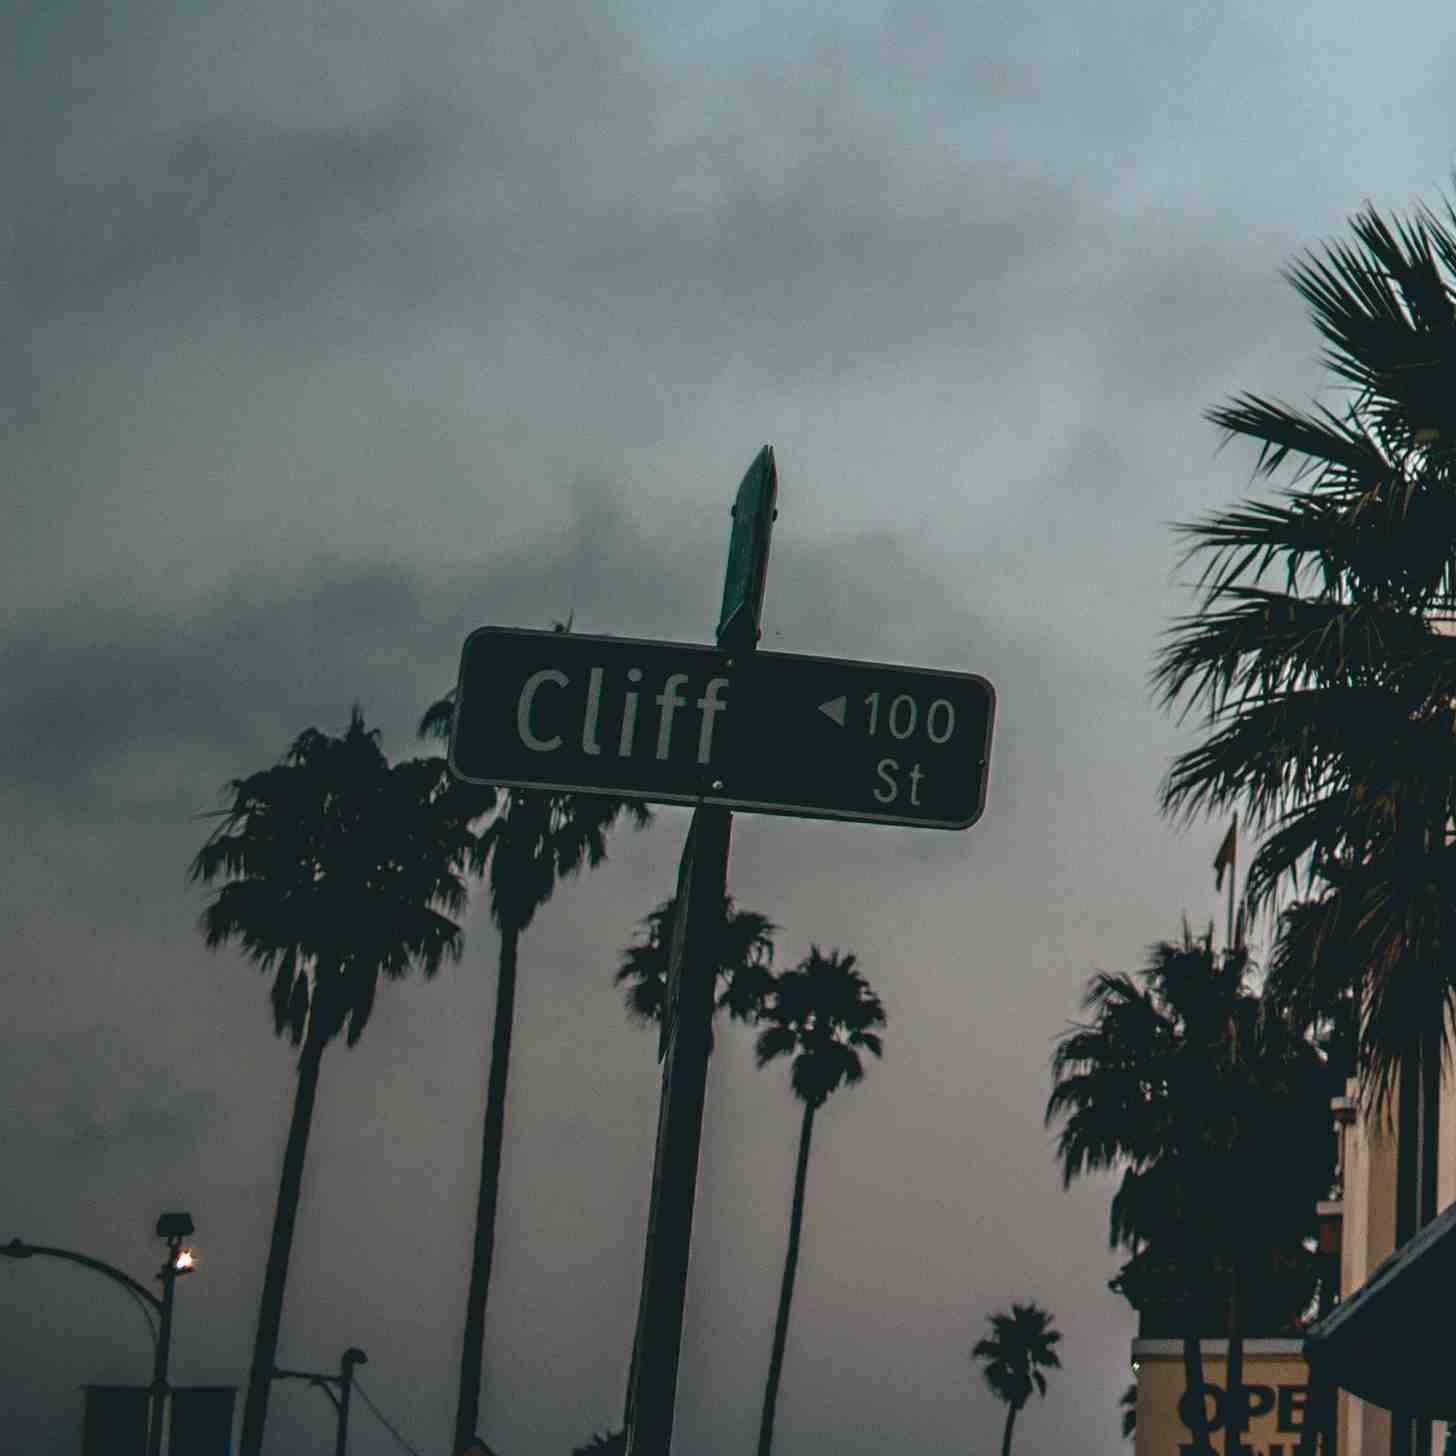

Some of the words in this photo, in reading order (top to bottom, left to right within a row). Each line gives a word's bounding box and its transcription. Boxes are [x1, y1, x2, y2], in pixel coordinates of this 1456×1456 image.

[514, 666, 730, 765] Cliff
[863, 690, 956, 745] 100
[871, 757, 926, 807] St
